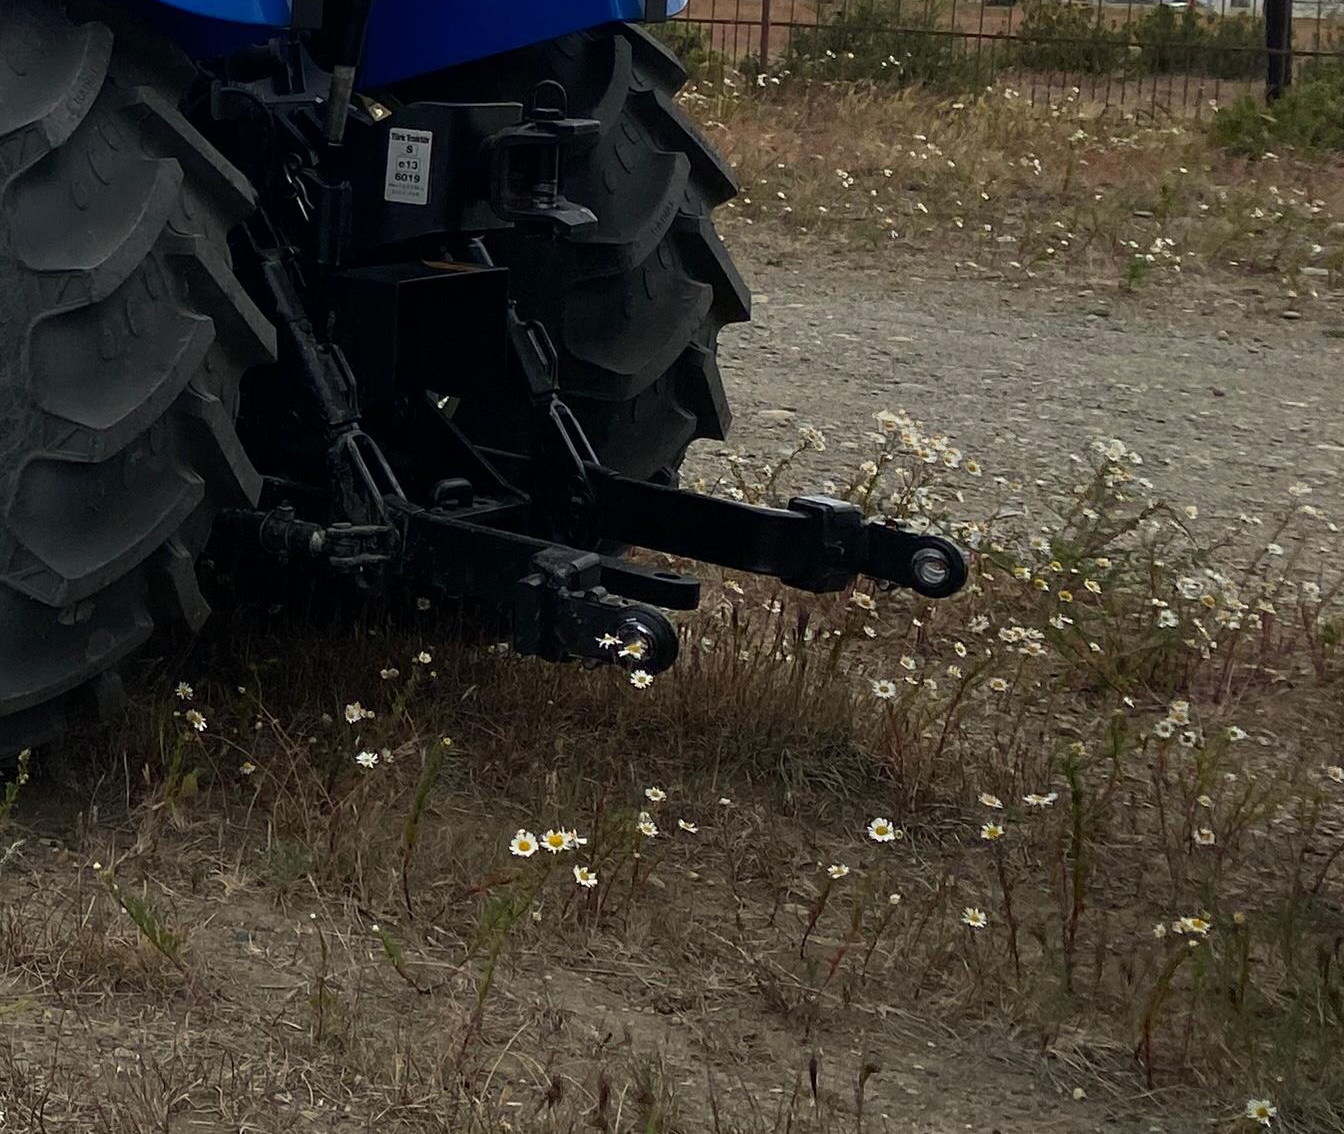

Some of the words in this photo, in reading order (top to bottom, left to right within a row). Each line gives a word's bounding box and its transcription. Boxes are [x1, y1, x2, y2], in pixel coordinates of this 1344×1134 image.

[406, 145, 413, 154] S
[398, 161, 418, 170] e13
[394, 172, 421, 183] 6019
